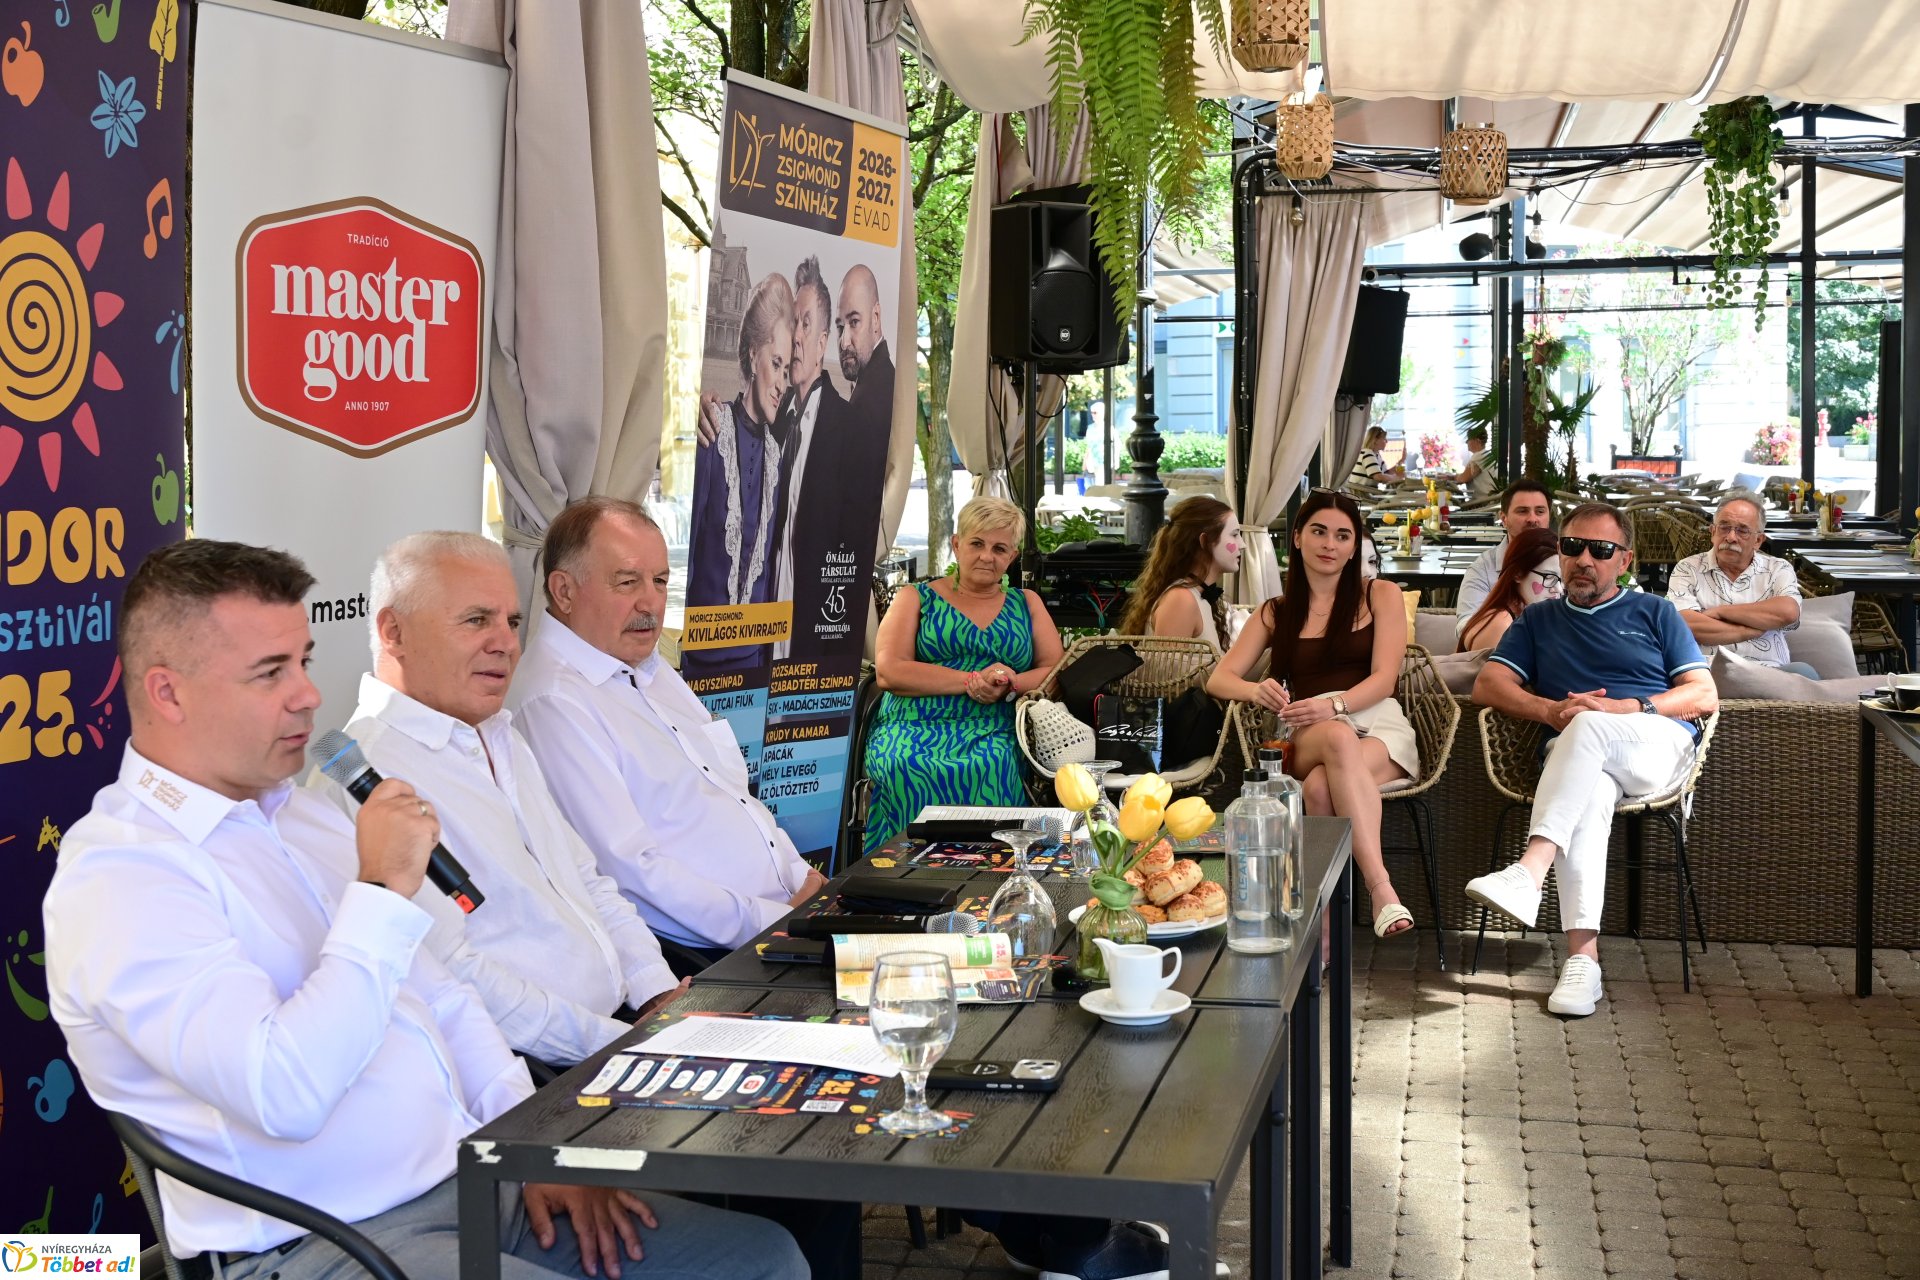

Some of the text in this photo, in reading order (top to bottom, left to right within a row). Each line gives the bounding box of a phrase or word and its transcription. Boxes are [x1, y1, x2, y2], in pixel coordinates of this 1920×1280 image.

[779, 122, 844, 166] MÓRICZ
[776, 155, 841, 189] ZSIGMOND
[858, 148, 896, 178] 2026-
[775, 180, 839, 220] SZÍNHÁZ
[856, 175, 894, 206] 2027.
[853, 201, 890, 231] ÉVAD
[347, 233, 389, 248] TRADÍCIÓ
[270, 256, 461, 326] master
[302, 319, 430, 402] good
[344, 401, 390, 411] ANNO 1907
[0, 507, 125, 586] DOR
[825, 551, 855, 563] ÖNÁLLÓ
[820, 565, 857, 577] TÁRSULAT
[307, 592, 370, 624] mast
[689, 611, 744, 624] MÓRICZ ZSIGMOND:
[0, 593, 112, 652] sztivál
[688, 620, 788, 642] KIVILÁGOS KIVIRRADTIG
[814, 622, 851, 633] ÉVFORDULÓJA
[771, 663, 818, 679] RÓZSAKERT
[770, 674, 854, 694] SZABADTÉRI SZÍNPAD
[711, 696, 734, 712] UTCAI
[734, 691, 754, 708] FIÚK
[782, 696, 819, 712] MADÁCH
[819, 693, 852, 710] SZÍNHÁZ
[765, 725, 830, 743] KRÚDY KAMARA
[763, 746, 794, 763] APÁCÁK
[761, 759, 817, 782] MÉLY LEVEGŐ
[769, 777, 820, 799] ÖLTÖZTETŐ
